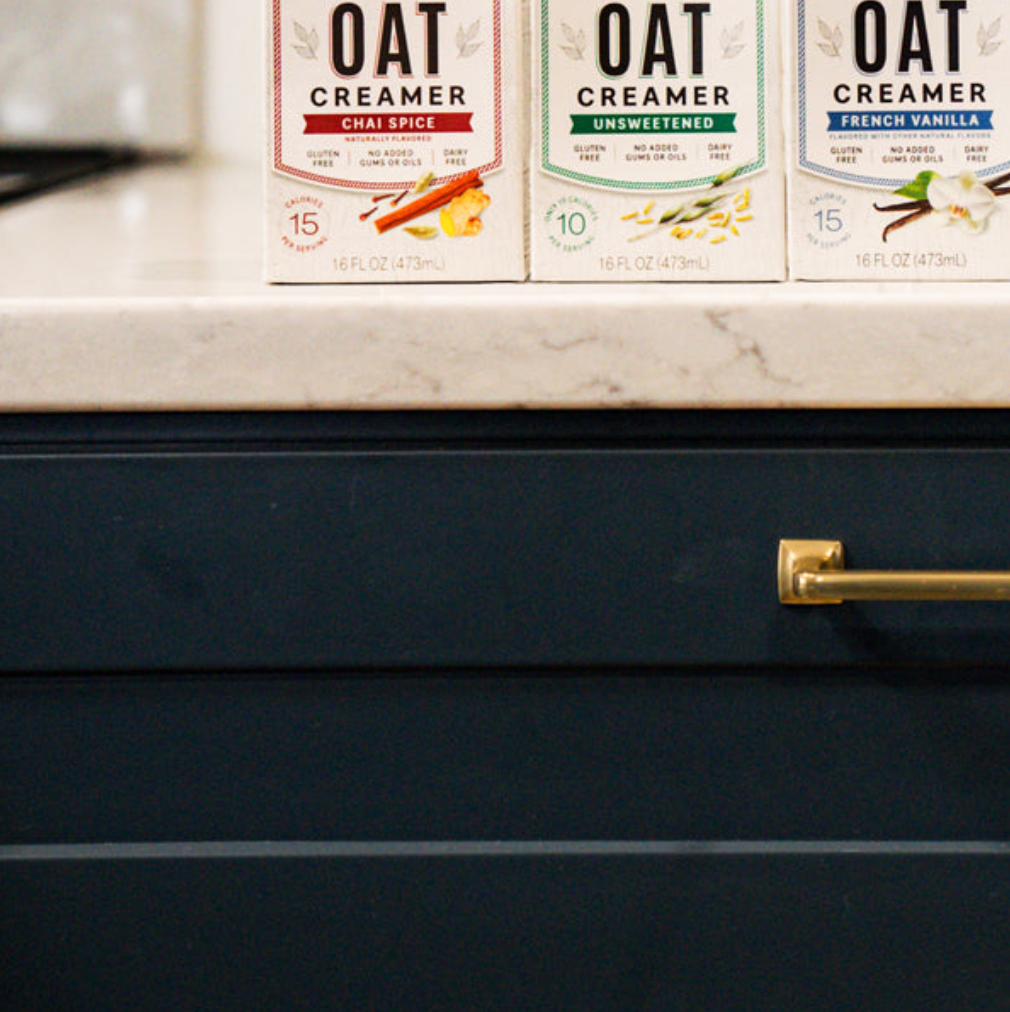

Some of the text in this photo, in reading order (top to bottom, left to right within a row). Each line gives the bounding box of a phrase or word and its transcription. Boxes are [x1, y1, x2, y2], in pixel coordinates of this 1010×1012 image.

[330, 2, 447, 77] OAT
[597, 3, 711, 79] OAT
[853, 0, 968, 76] OAT
[310, 86, 466, 106] CREAMER
[577, 86, 729, 107] CREAMER
[834, 83, 986, 104] CREAMER
[342, 117, 435, 130] CHAI SPICE
[594, 118, 714, 130] UNSWEETENED
[842, 114, 979, 127] FRENCH VANILLA
[307, 150, 339, 158] GLUTEN
[384, 149, 414, 157] ADDED
[443, 149, 468, 157] DAIRY
[910, 155, 922, 163] OR
[360, 159, 385, 167] GUMS
[404, 158, 421, 166] OILS
[290, 213, 319, 235] 15
[557, 212, 586, 235] 10
[814, 209, 843, 231] 15
[334, 256, 445, 271] 16 FL OZ (473mL)
[599, 256, 709, 271] 16 FL OZ (473mL)
[855, 253, 966, 268] 16 FL OZ (473mL)
